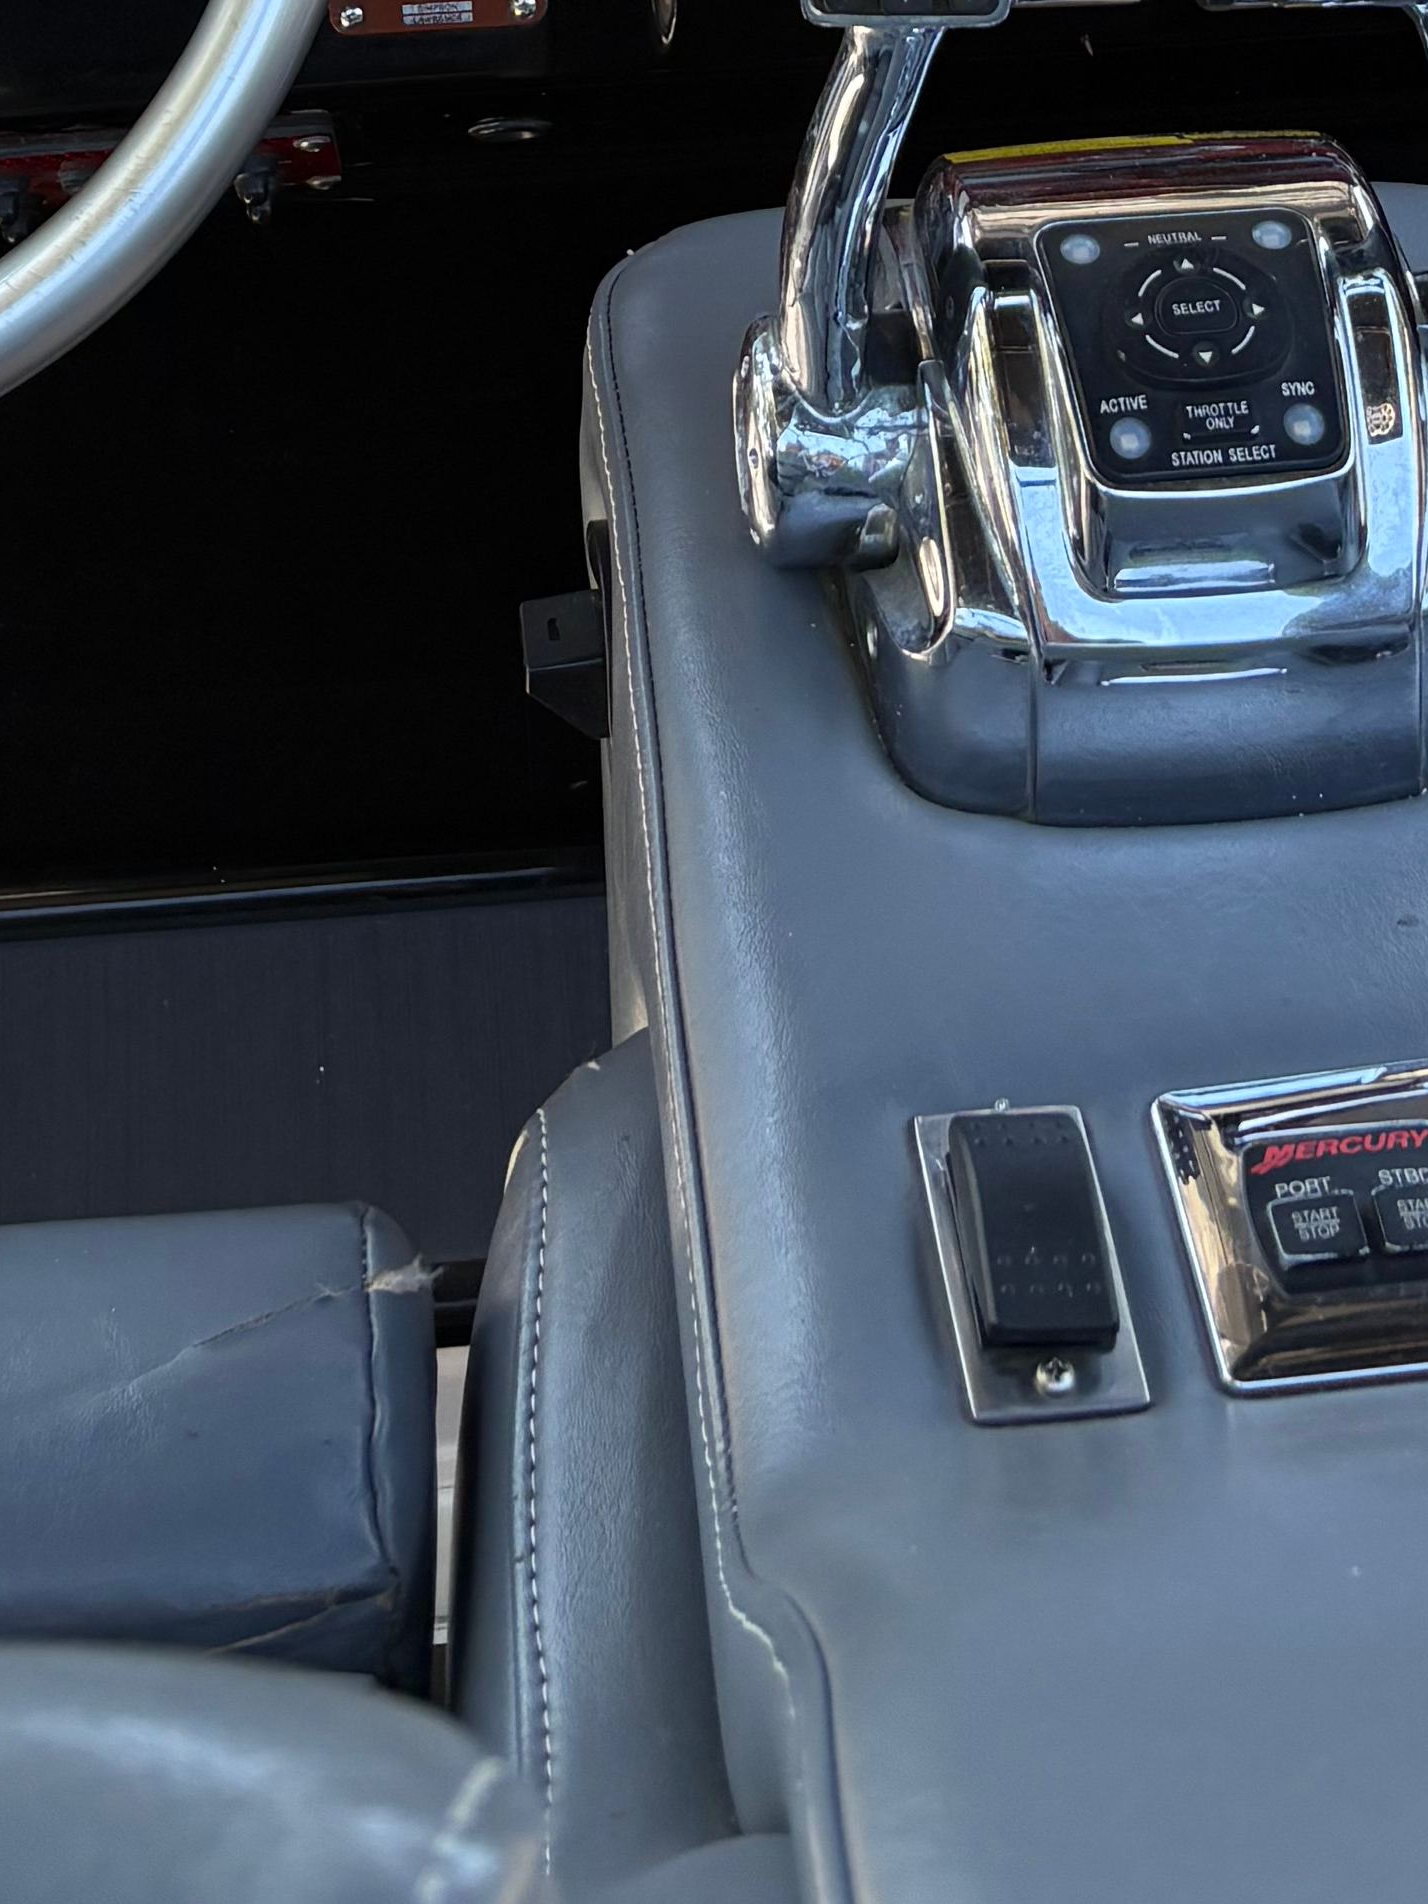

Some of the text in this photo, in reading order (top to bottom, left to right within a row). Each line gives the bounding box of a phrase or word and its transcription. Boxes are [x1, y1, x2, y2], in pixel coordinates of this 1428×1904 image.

[1147, 231, 1202, 245] NEUTRAL
[1172, 299, 1221, 316] SELECT
[1280, 381, 1315, 396] SYNC
[1099, 395, 1148, 414] ACTIVE
[1186, 401, 1249, 419] THROTTLE
[1205, 416, 1235, 431] ONLY
[1171, 444, 1276, 467] STATION SELECT
[1275, 1175, 1331, 1199] PORT
[1291, 1206, 1339, 1223] START
[1298, 1224, 1340, 1241] STOP
